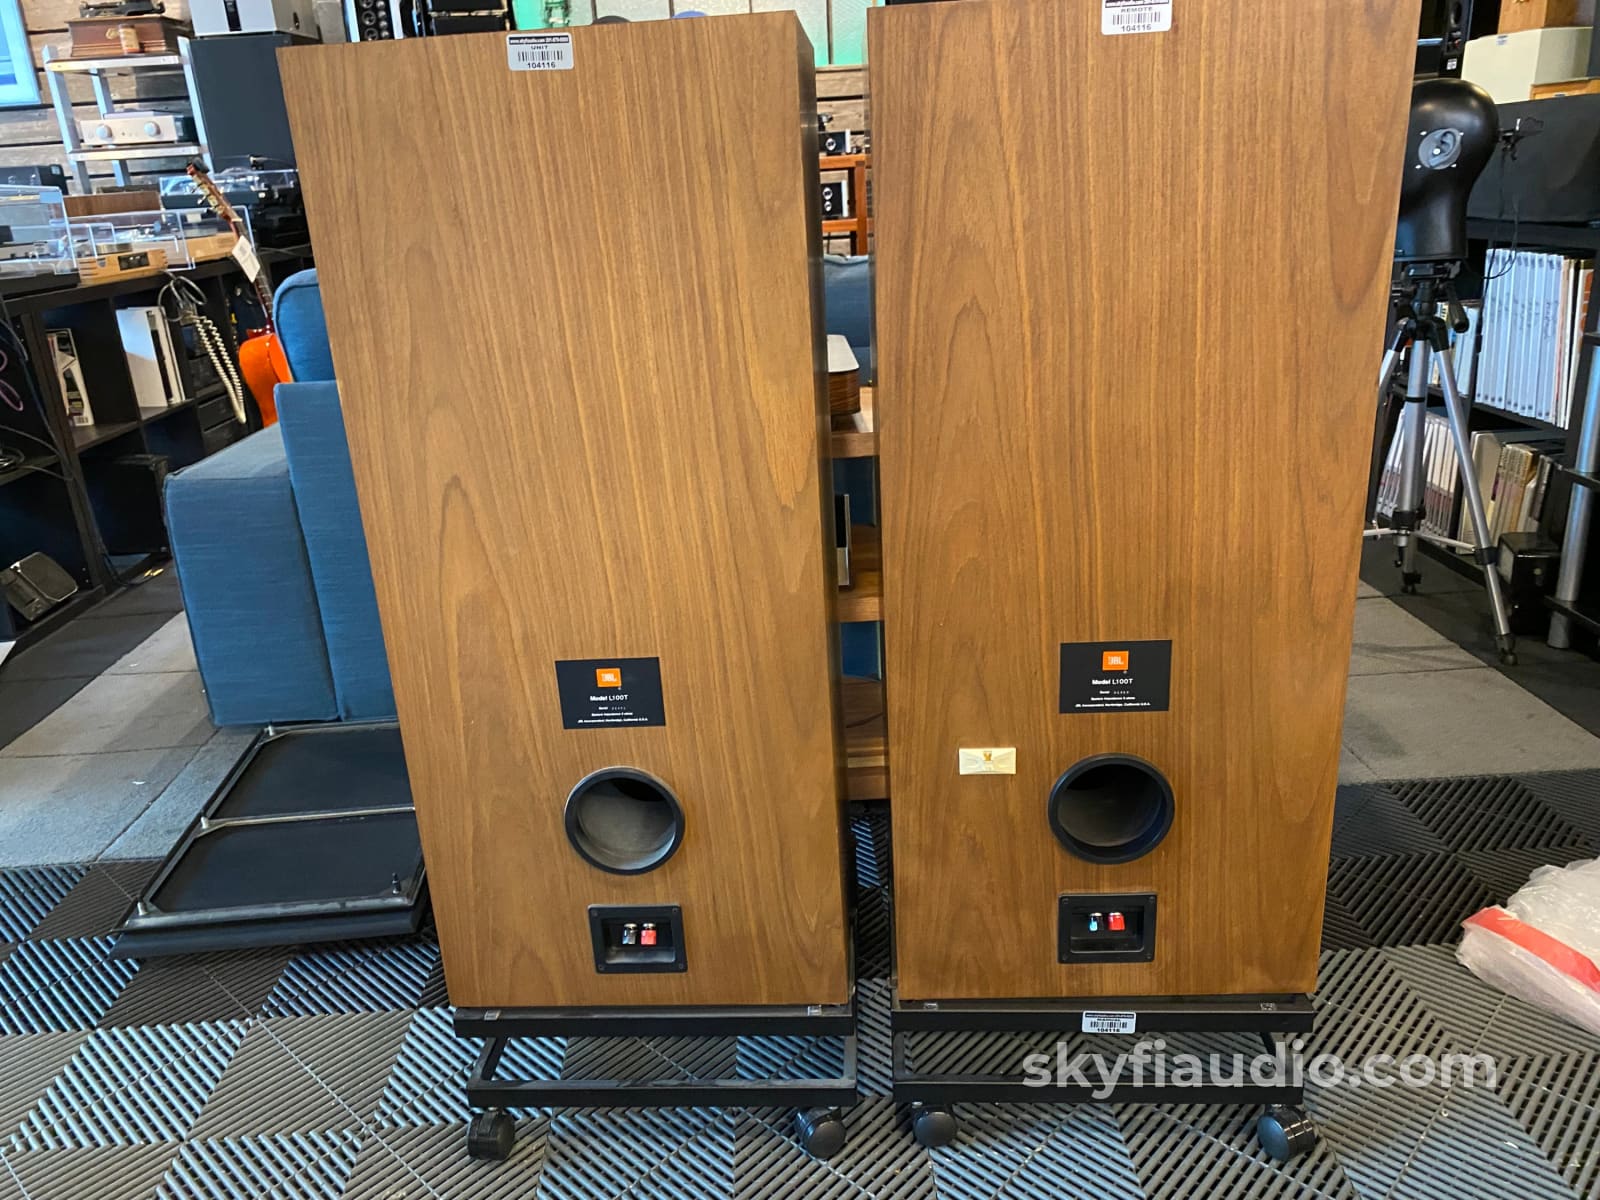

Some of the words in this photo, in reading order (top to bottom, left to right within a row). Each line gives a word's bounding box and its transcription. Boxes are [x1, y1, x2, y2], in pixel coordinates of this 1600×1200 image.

[1121, 24, 1152, 32] 104116
[527, 61, 556, 69] 104116
[1107, 656, 1124, 665] JBL
[601, 673, 617, 683] JBL
